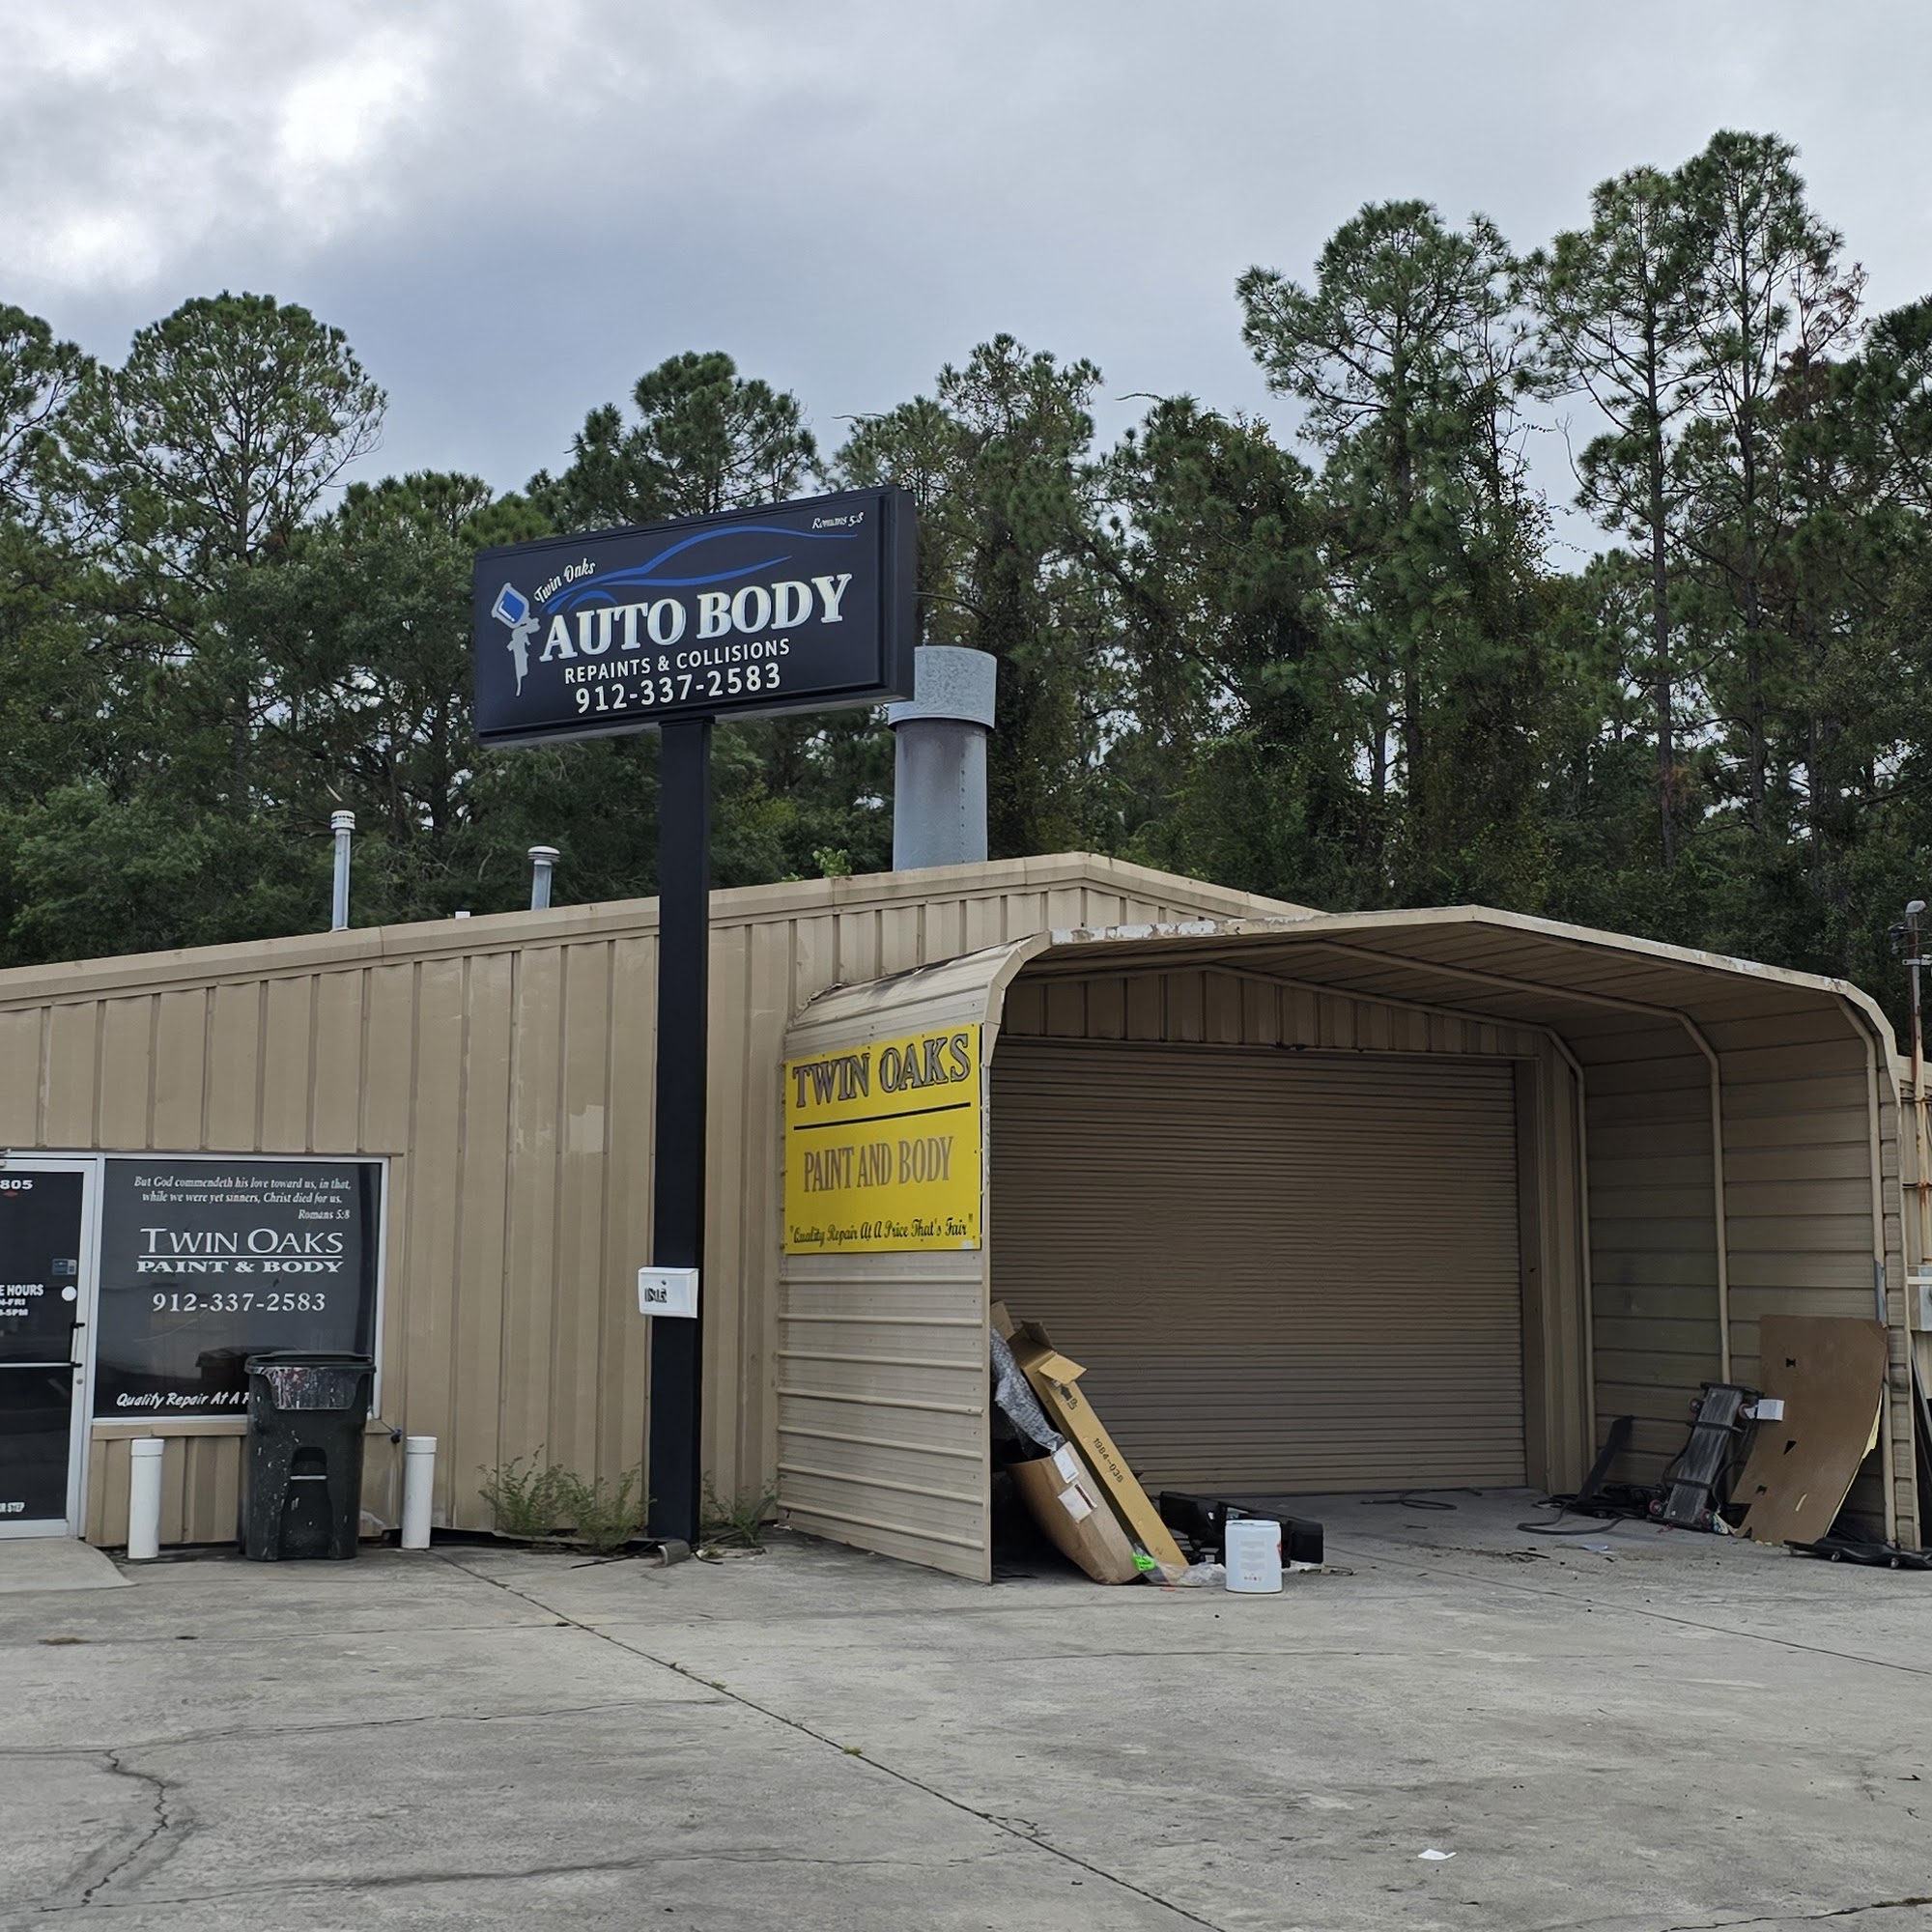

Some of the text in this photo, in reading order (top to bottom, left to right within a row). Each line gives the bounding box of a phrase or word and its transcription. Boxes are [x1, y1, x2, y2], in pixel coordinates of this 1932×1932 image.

[533, 557, 596, 603] Twin Oaks
[539, 573, 853, 663] AUTO BODY
[564, 638, 790, 684] REPAINTS & COLLISIONS
[575, 662, 781, 714] 912-337-2583
[792, 1033, 972, 1108] TWIN OAKS
[804, 1136, 954, 1193] PAINT AND BODY
[133, 1176, 152, 1187] But
[154, 1176, 174, 1187] God
[175, 1177, 233, 1188] commendeth
[235, 1177, 249, 1188] his
[250, 1177, 270, 1189] love
[270, 1178, 303, 1189] toward
[304, 1179, 317, 1190] us,
[319, 1178, 329, 1189] in
[142, 1190, 168, 1202] while
[170, 1193, 184, 1203] we
[185, 1193, 209, 1203] were
[209, 1193, 224, 1205] yet
[263, 1191, 292, 1204] Christ
[292, 1192, 314, 1204] died
[314, 1192, 327, 1205] for
[298, 1208, 351, 1220] Romans 5:8
[860, 1221, 872, 1240] At
[874, 1220, 883, 1238] A
[884, 1219, 909, 1238] Price
[911, 1217, 942, 1237] That's
[136, 1261, 344, 1273] PAINT & BODY
[7, 1284, 44, 1296] HOURS
[153, 1293, 326, 1312] 912-337-2583
[116, 1392, 165, 1409] Quality
[165, 1392, 210, 1408] Repair
[210, 1391, 229, 1405] At
[229, 1391, 241, 1405] A
